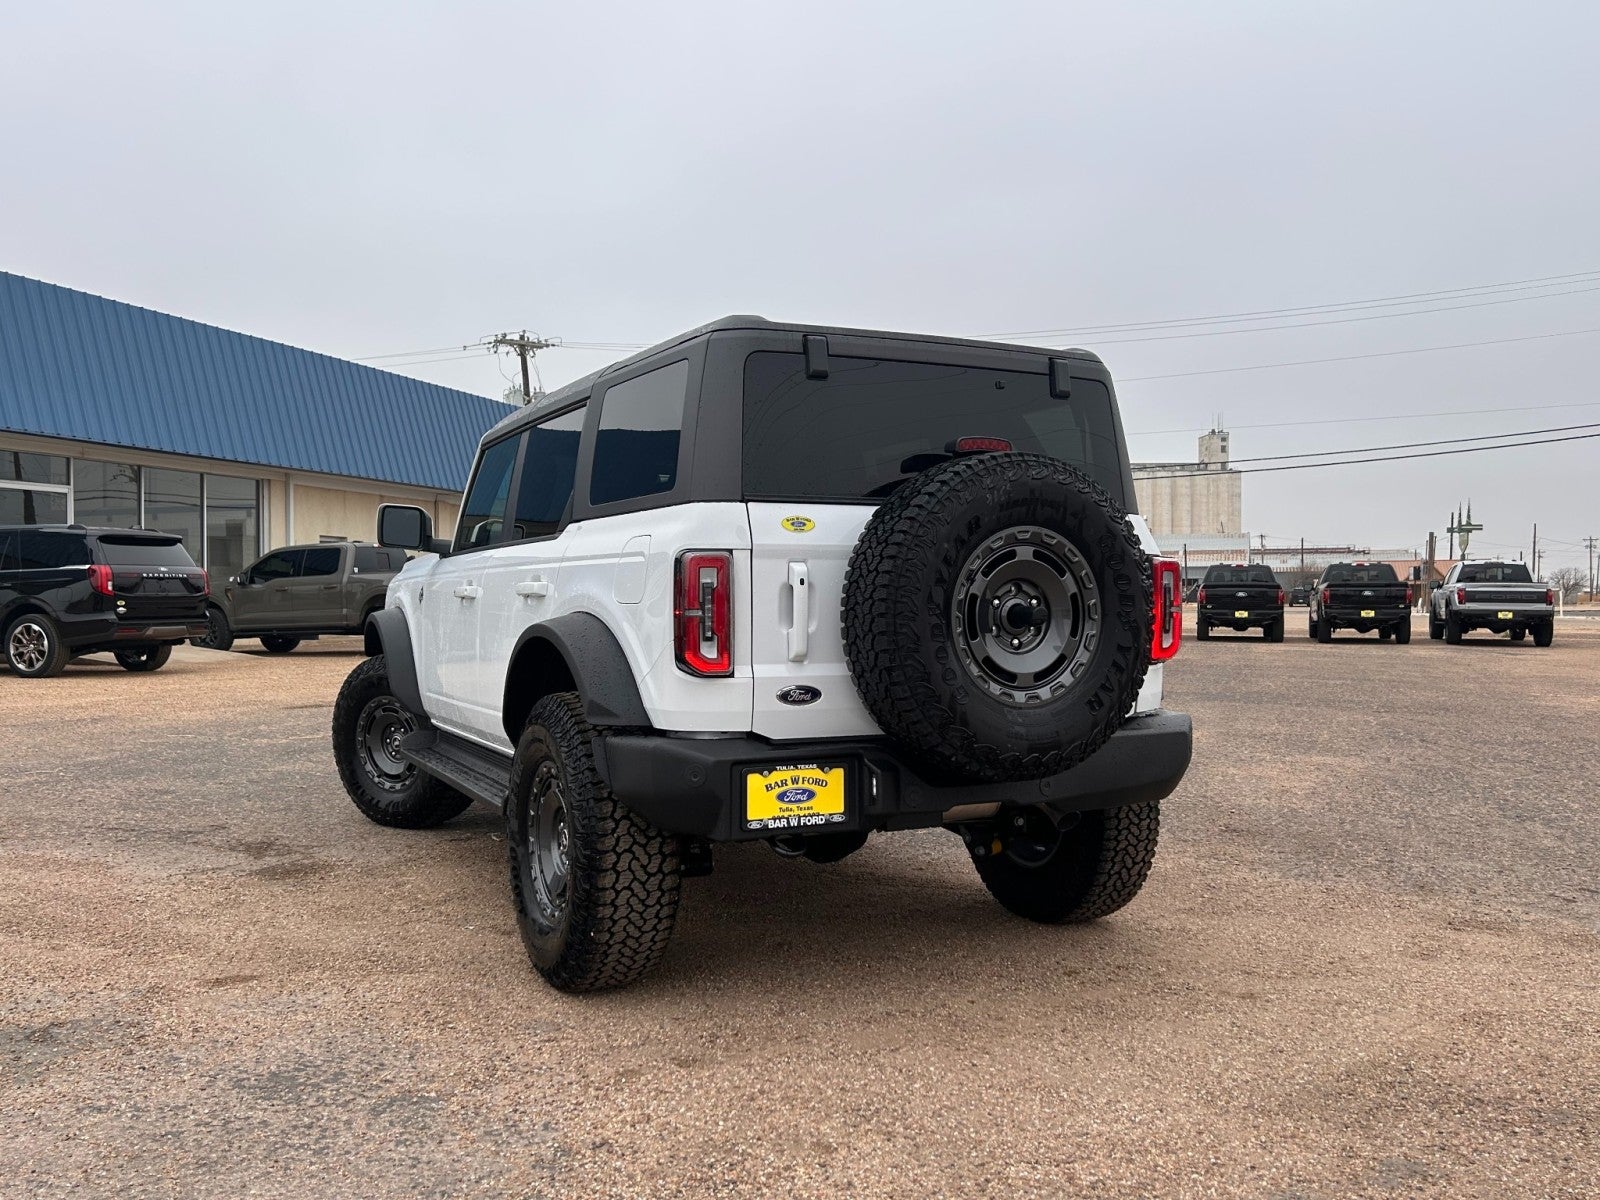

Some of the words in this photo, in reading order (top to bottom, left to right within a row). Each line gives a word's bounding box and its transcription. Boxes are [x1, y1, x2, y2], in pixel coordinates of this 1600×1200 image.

[788, 690, 812, 701] Ford
[765, 779, 788, 792] BAR
[791, 775, 800, 785] W
[802, 777, 828, 788] FORD
[784, 789, 808, 801] Ford
[768, 818, 788, 829] BAR
[788, 818, 799, 827] W
[801, 816, 826, 825] FORD
